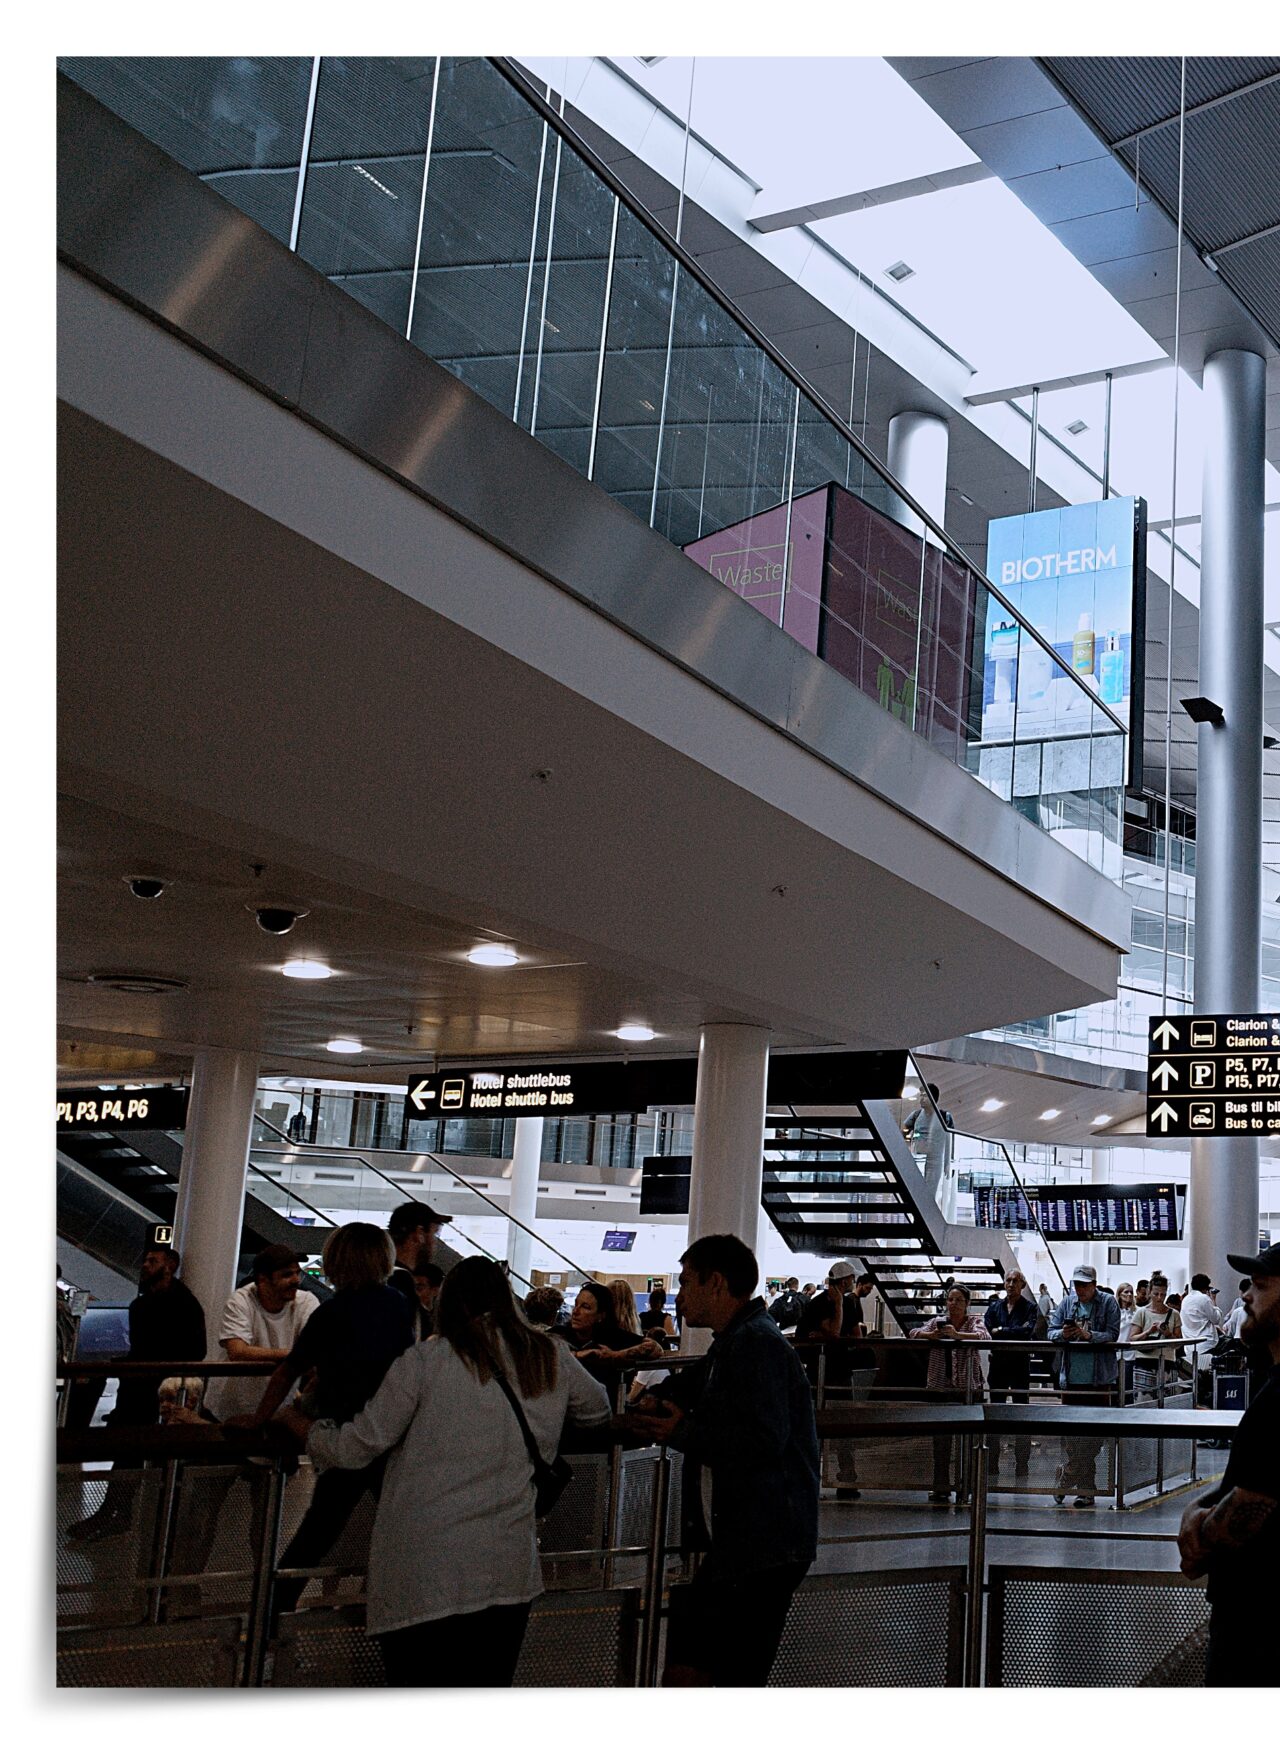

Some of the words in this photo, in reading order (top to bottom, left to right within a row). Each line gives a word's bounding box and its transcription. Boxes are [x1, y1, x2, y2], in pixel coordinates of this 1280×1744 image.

[1002, 544, 1117, 585] BIOTHERM
[718, 561, 783, 587] Waste
[1227, 1019, 1267, 1030] Clarion
[1271, 1019, 1280, 1030] &
[1226, 1036, 1267, 1047] Clarion
[1271, 1035, 1280, 1046] &
[1226, 1059, 1247, 1072] P5,
[1252, 1058, 1272, 1072] P7,
[473, 1075, 504, 1089] Hotel
[507, 1073, 571, 1088] shuttlebus
[1226, 1075, 1252, 1089] P15,
[470, 1093, 502, 1108] Hotel
[505, 1092, 547, 1106] shuttle
[550, 1091, 574, 1104] bus
[57, 1103, 73, 1123] P1,
[76, 1101, 98, 1122] P3,
[101, 1101, 124, 1121] P4,
[128, 1099, 148, 1118] P6
[1226, 1102, 1247, 1113] Bus
[1251, 1102, 1262, 1112] til
[1226, 1118, 1247, 1128] Bus
[1251, 1118, 1263, 1128] to
